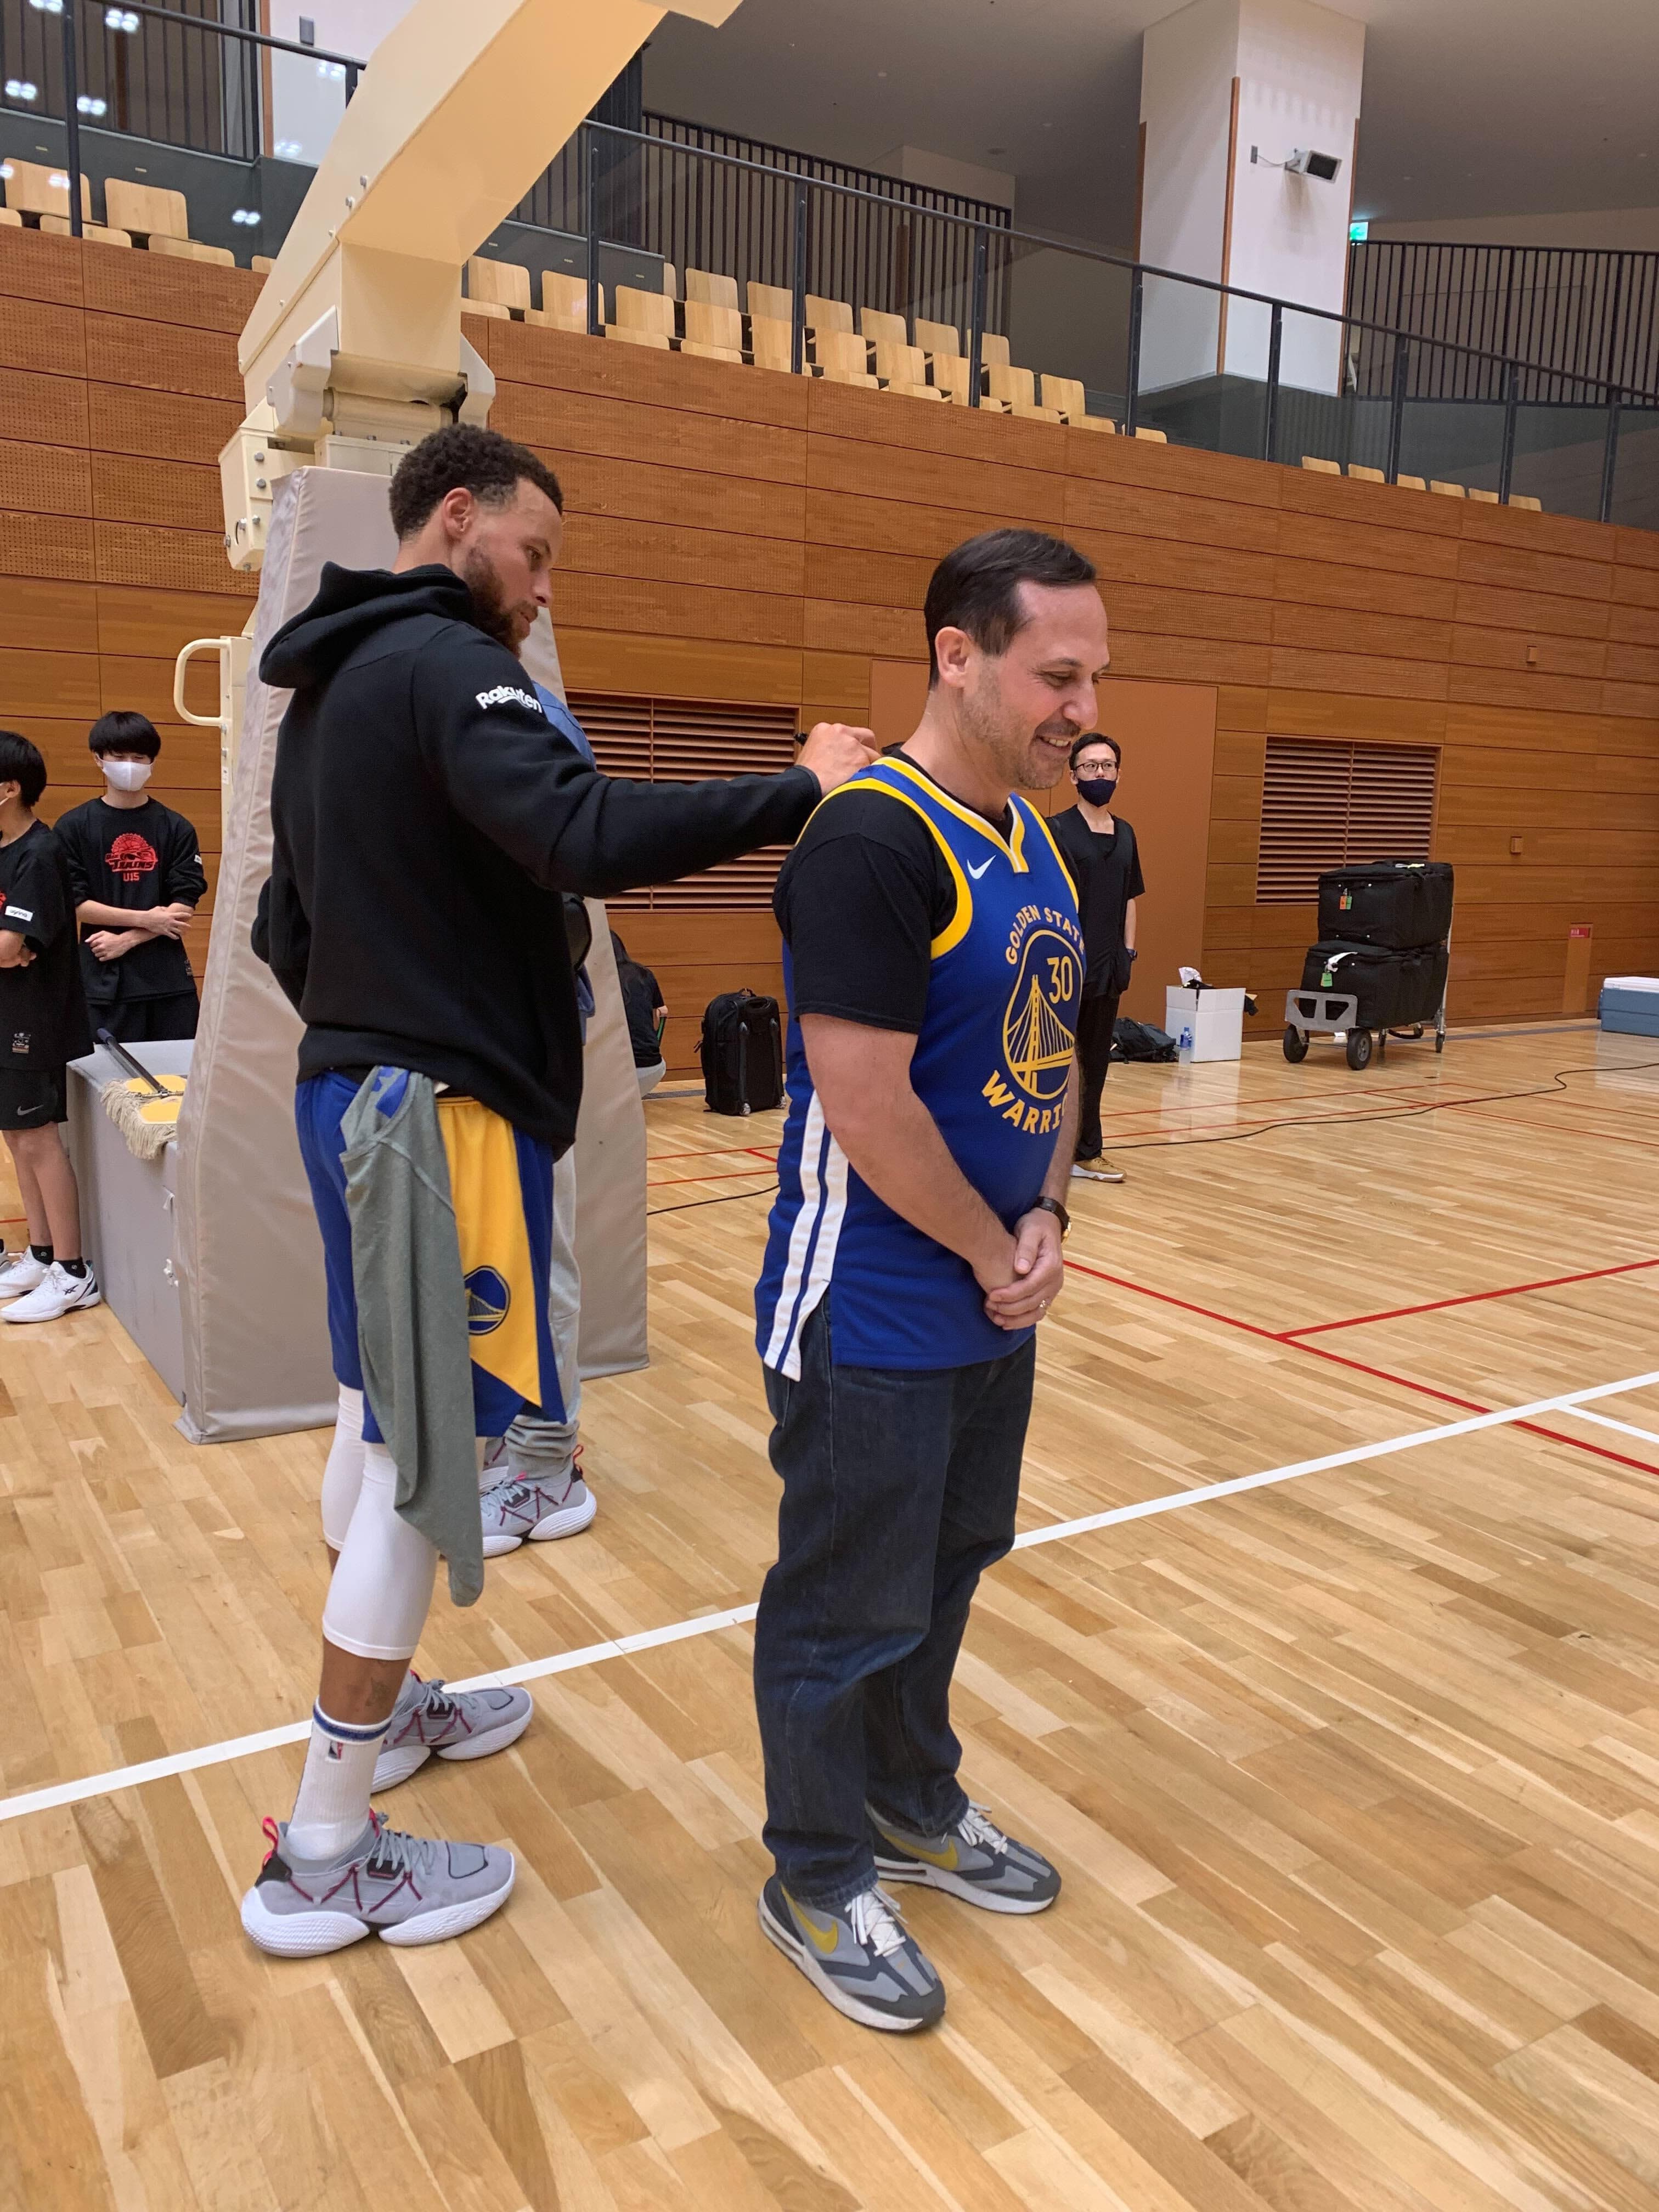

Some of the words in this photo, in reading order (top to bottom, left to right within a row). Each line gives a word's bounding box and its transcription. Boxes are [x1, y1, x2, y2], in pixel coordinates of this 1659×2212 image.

[476, 685, 543, 713] Rakuten
[123, 873, 140, 881] U15
[1006, 905, 1041, 964] GOLDEN
[1044, 907, 1085, 955] STATE
[1047, 956, 1073, 1004] 30
[981, 1070, 1068, 1134] WARRI
